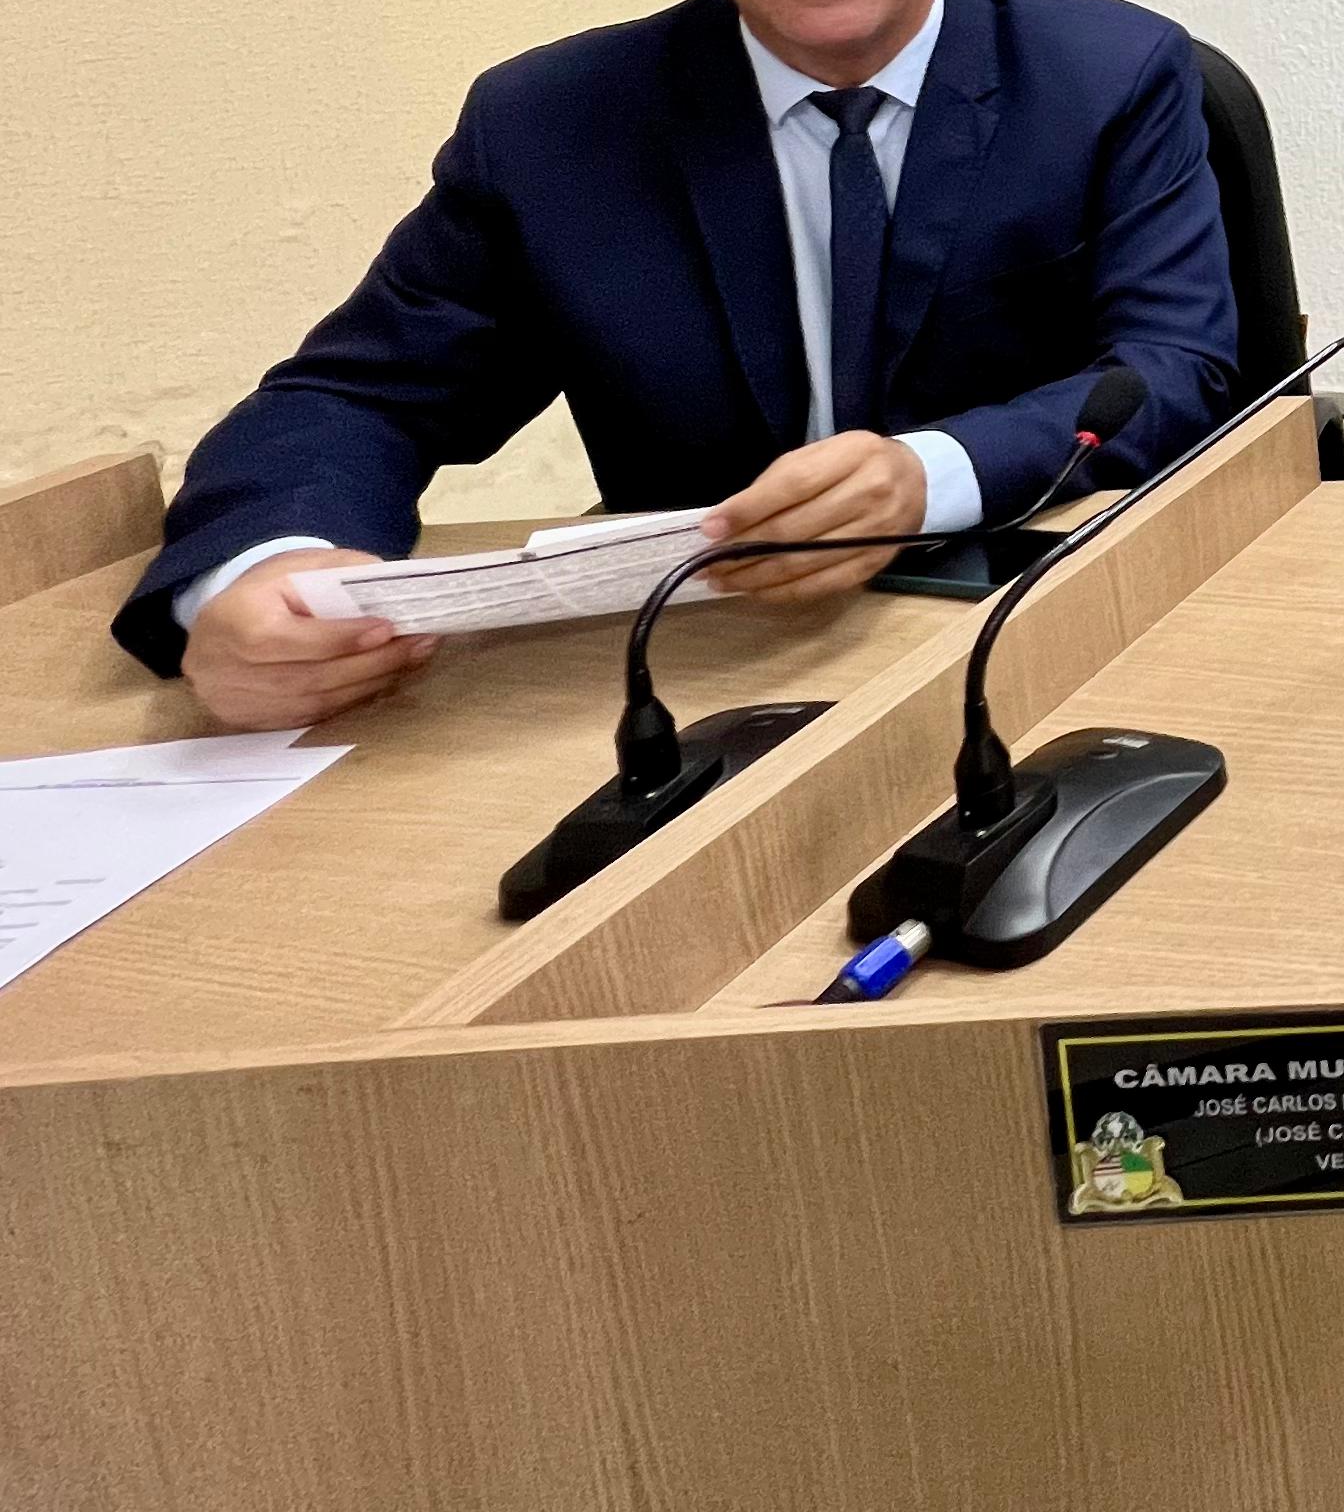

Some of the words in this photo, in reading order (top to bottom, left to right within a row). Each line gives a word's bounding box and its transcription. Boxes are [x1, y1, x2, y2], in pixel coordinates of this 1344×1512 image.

[1113, 1063, 1278, 1089] CÂMARA
[1193, 1092, 1249, 1119] JOSÉ
[1252, 1091, 1338, 1116] CARLOS
[1254, 1122, 1322, 1149] (JOSÉ
